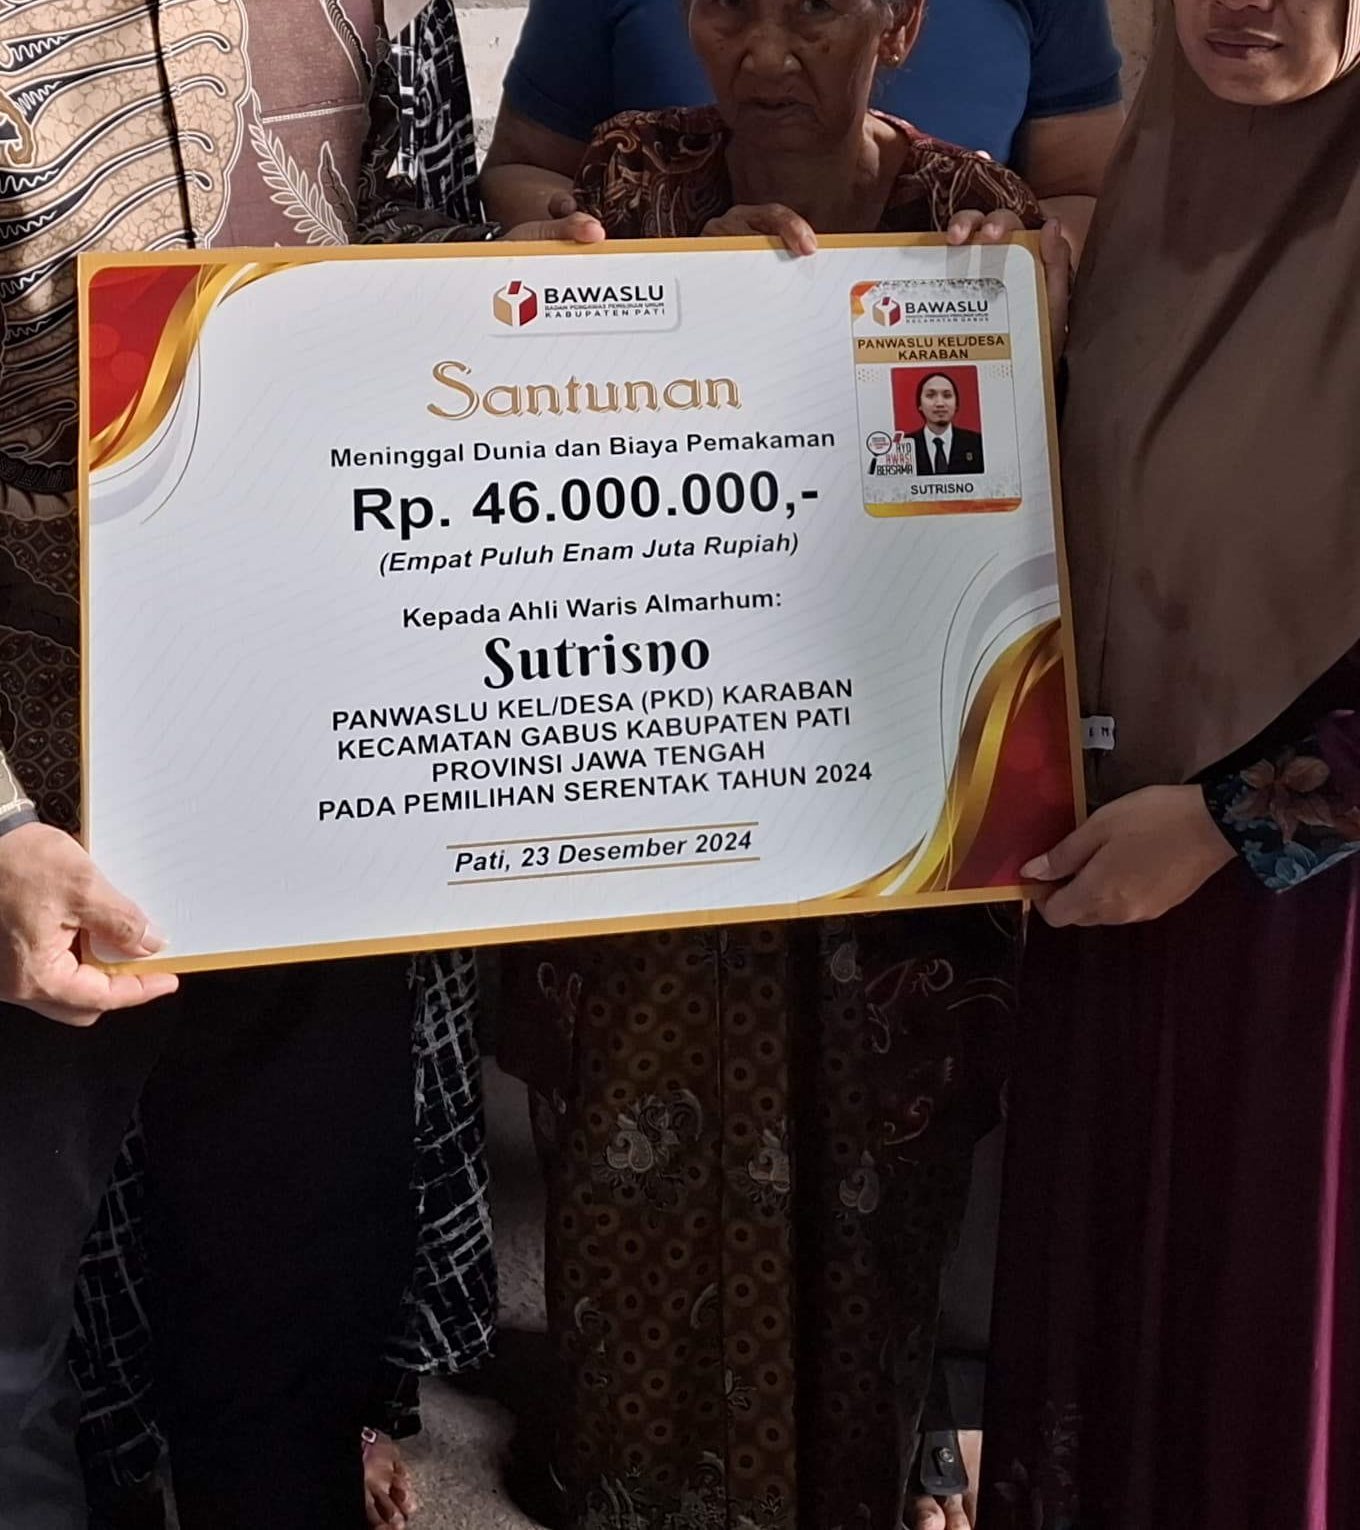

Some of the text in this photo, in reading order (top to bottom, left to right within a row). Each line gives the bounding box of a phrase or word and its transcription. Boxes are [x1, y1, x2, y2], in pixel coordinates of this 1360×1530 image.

[544, 285, 664, 303] BAWASLU
[545, 308, 665, 318] KABUPATEN PATI
[905, 300, 988, 314] BAWASLU
[857, 335, 1004, 349] PANWASLU KEL/DESA
[898, 349, 969, 360] KARABAN
[428, 360, 740, 420] Santunan
[331, 432, 834, 468] Meninggal Dunia dan Biaya Pemakaman
[354, 471, 818, 540] Rp. 46.000.000,-
[910, 482, 974, 495] SUTRISNO
[380, 533, 798, 577] (Empat Puluh Enam Juta Rupiah)
[404, 591, 781, 630] Kepada Ahli Waris Almarhum:
[484, 634, 709, 689] Sutrisno
[333, 679, 852, 731] PANWASLU KEL/DESA (PKD) KARABAN
[339, 707, 849, 760] KECAMATAN GABUS KABUPATEN PATI
[433, 741, 764, 782] PROVINSI JAWA TENGAH
[320, 762, 872, 821] PADA PEMILIHAN SERENTAK TAHUN 2024
[456, 831, 751, 872] Pati, 23 Desember 2024
